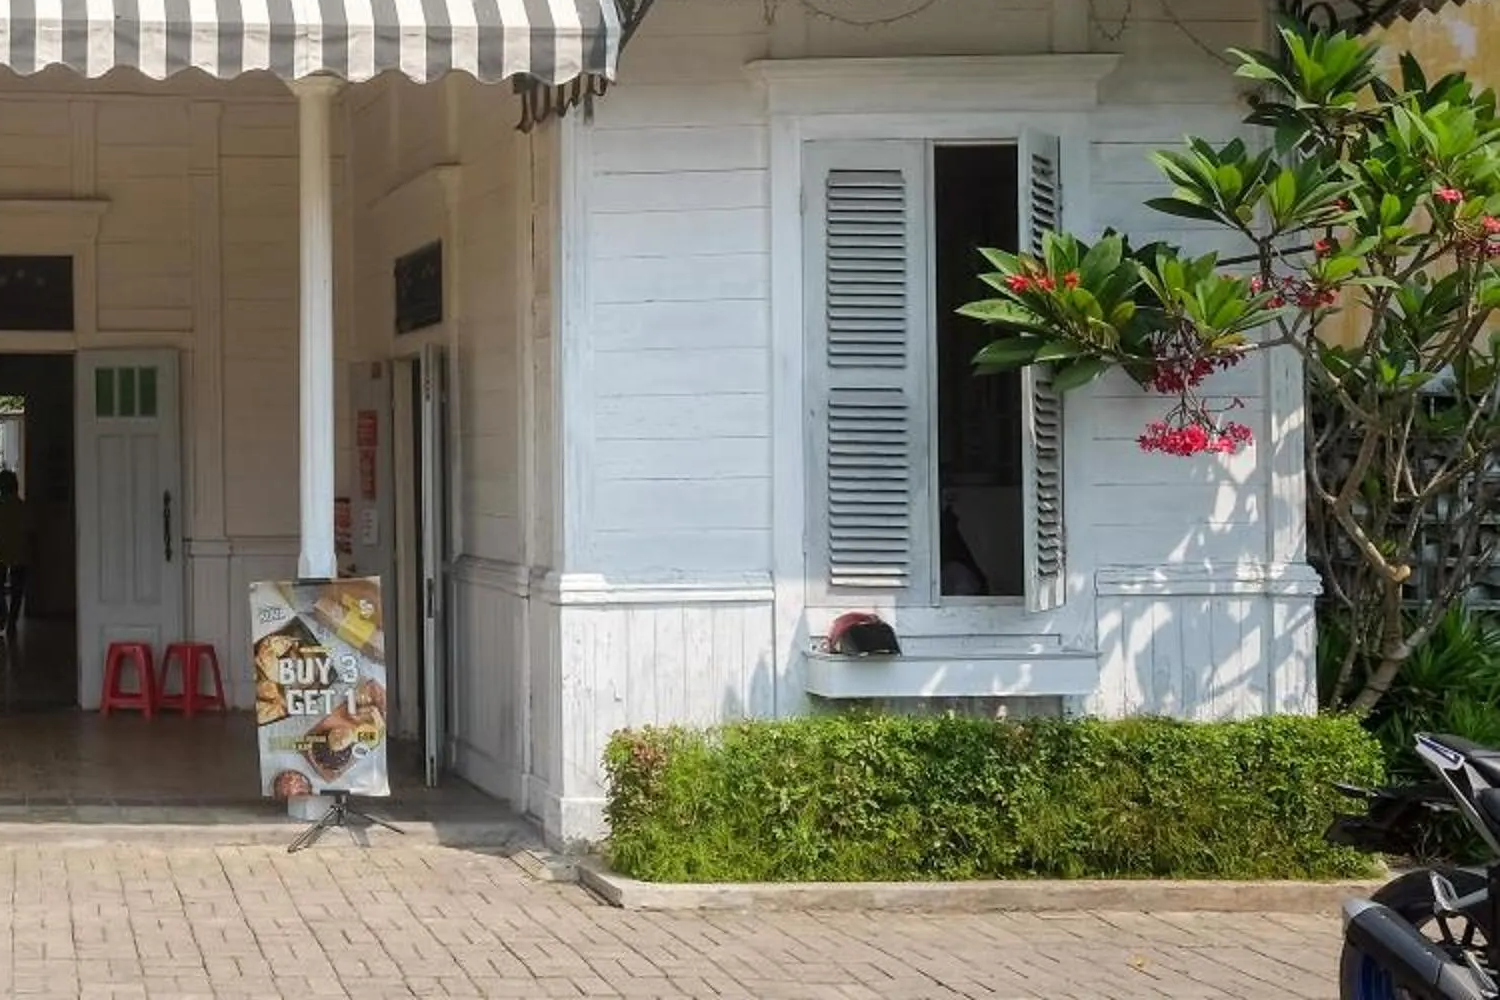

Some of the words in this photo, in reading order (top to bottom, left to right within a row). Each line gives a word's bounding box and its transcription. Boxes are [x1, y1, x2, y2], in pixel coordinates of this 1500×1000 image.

[279, 657, 331, 685] BUY
[286, 689, 335, 715] GET
[345, 687, 357, 715] 1
